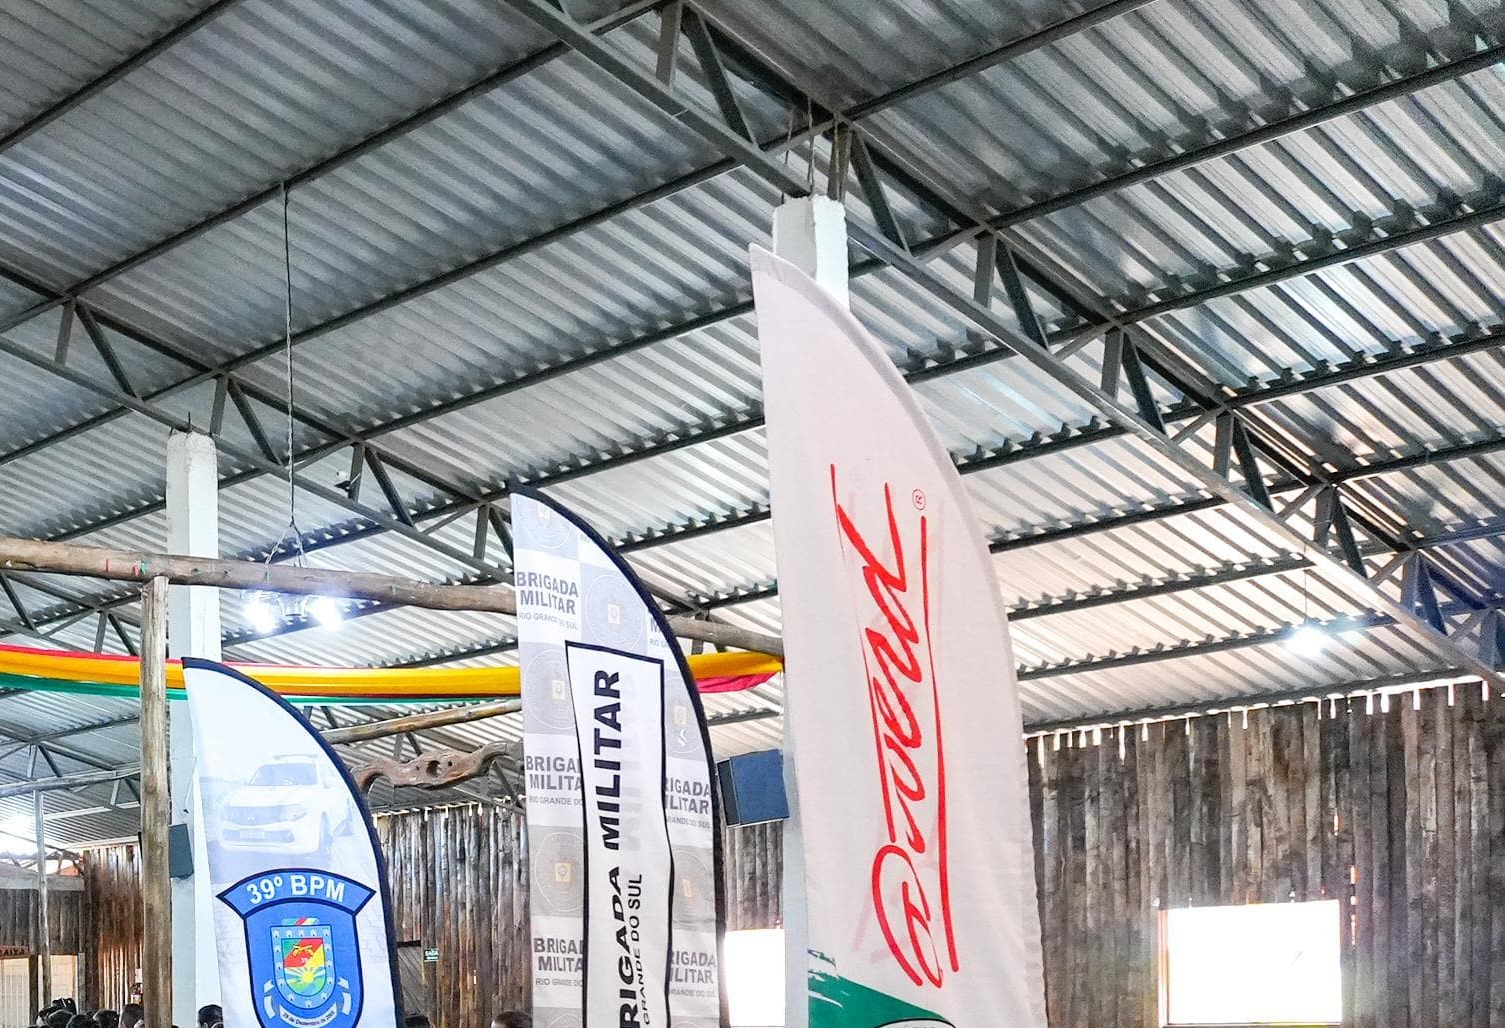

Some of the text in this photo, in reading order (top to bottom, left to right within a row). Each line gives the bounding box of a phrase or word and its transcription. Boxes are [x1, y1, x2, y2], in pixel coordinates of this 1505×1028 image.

[516, 571, 579, 597] BRIGADA
[520, 590, 576, 615] MILITAR
[835, 476, 947, 988] Proerd
[594, 670, 622, 850] MILITAR
[290, 875, 345, 903] BPM
[628, 874, 643, 910] SUL
[628, 915, 640, 942] DO
[536, 977, 550, 986] RIO
[634, 950, 651, 1026] GRANDE
